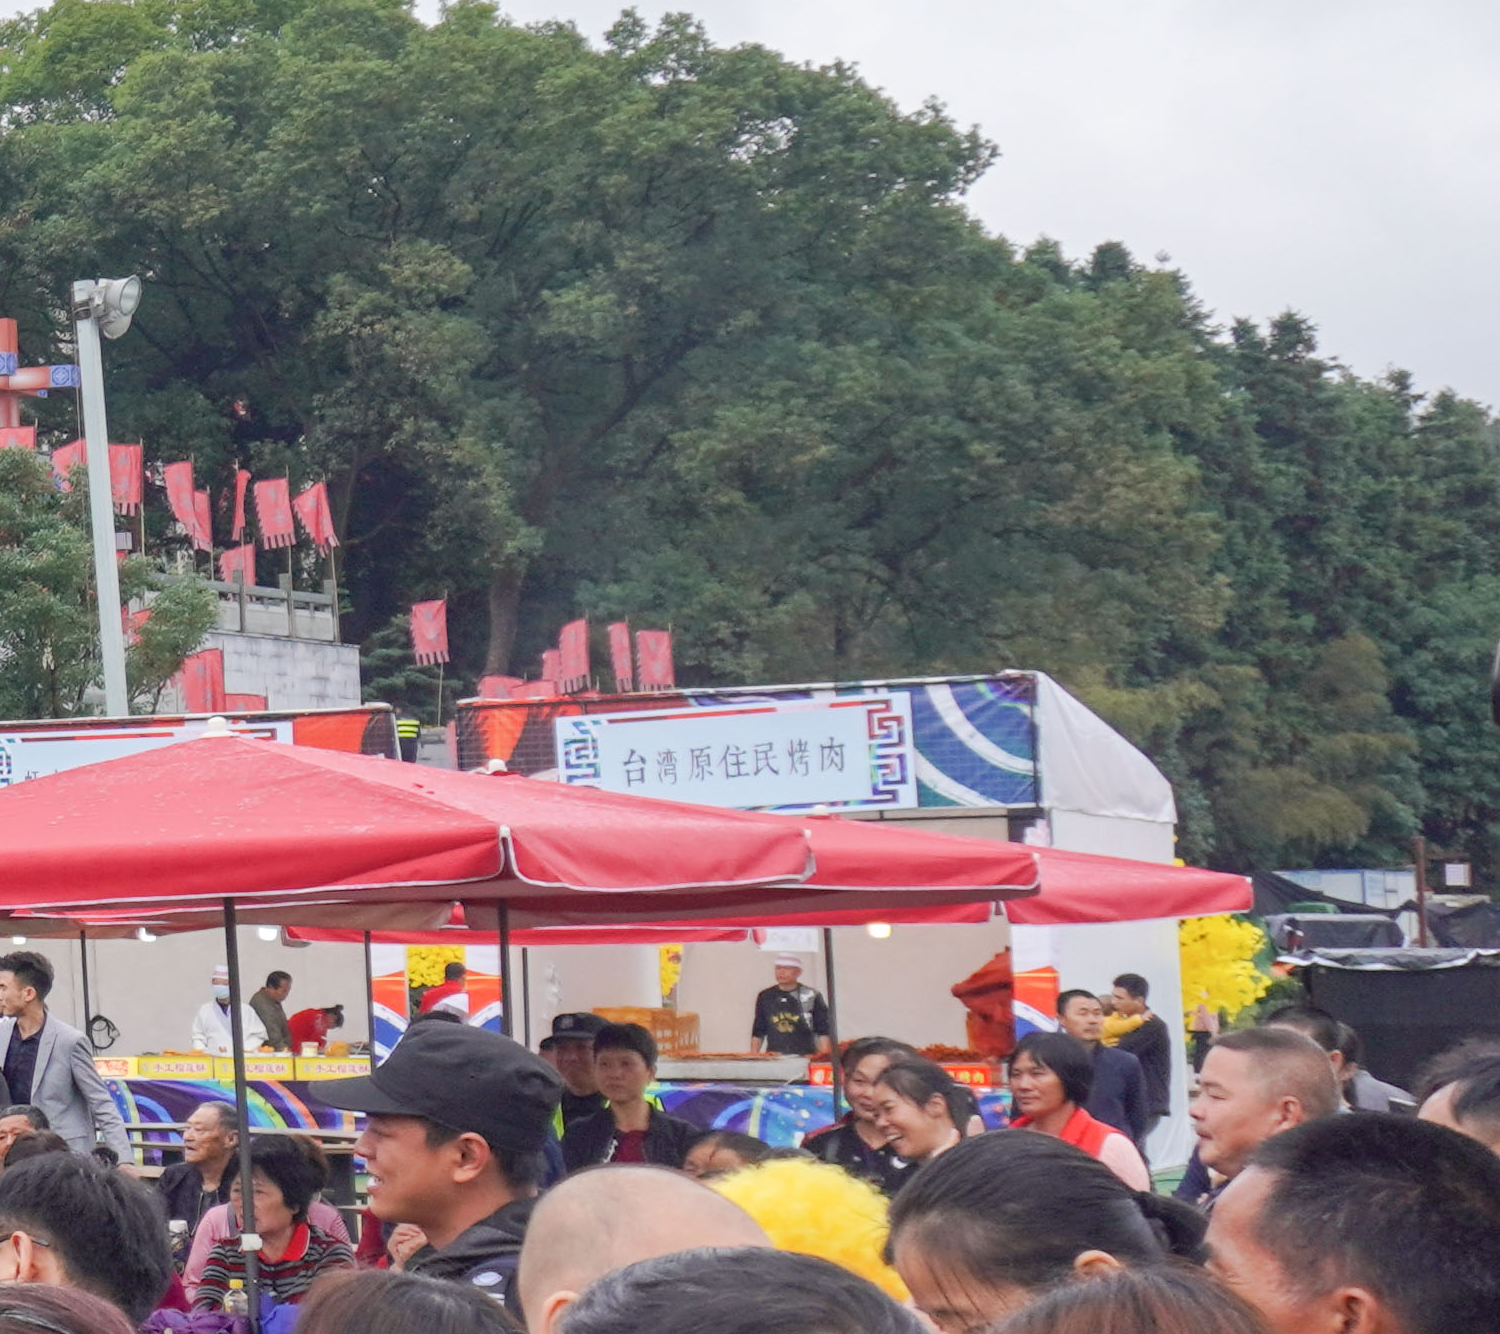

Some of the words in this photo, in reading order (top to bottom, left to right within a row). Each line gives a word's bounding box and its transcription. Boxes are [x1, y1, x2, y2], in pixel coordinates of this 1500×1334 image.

[622, 736, 846, 788] 台湾原住民烤肉
